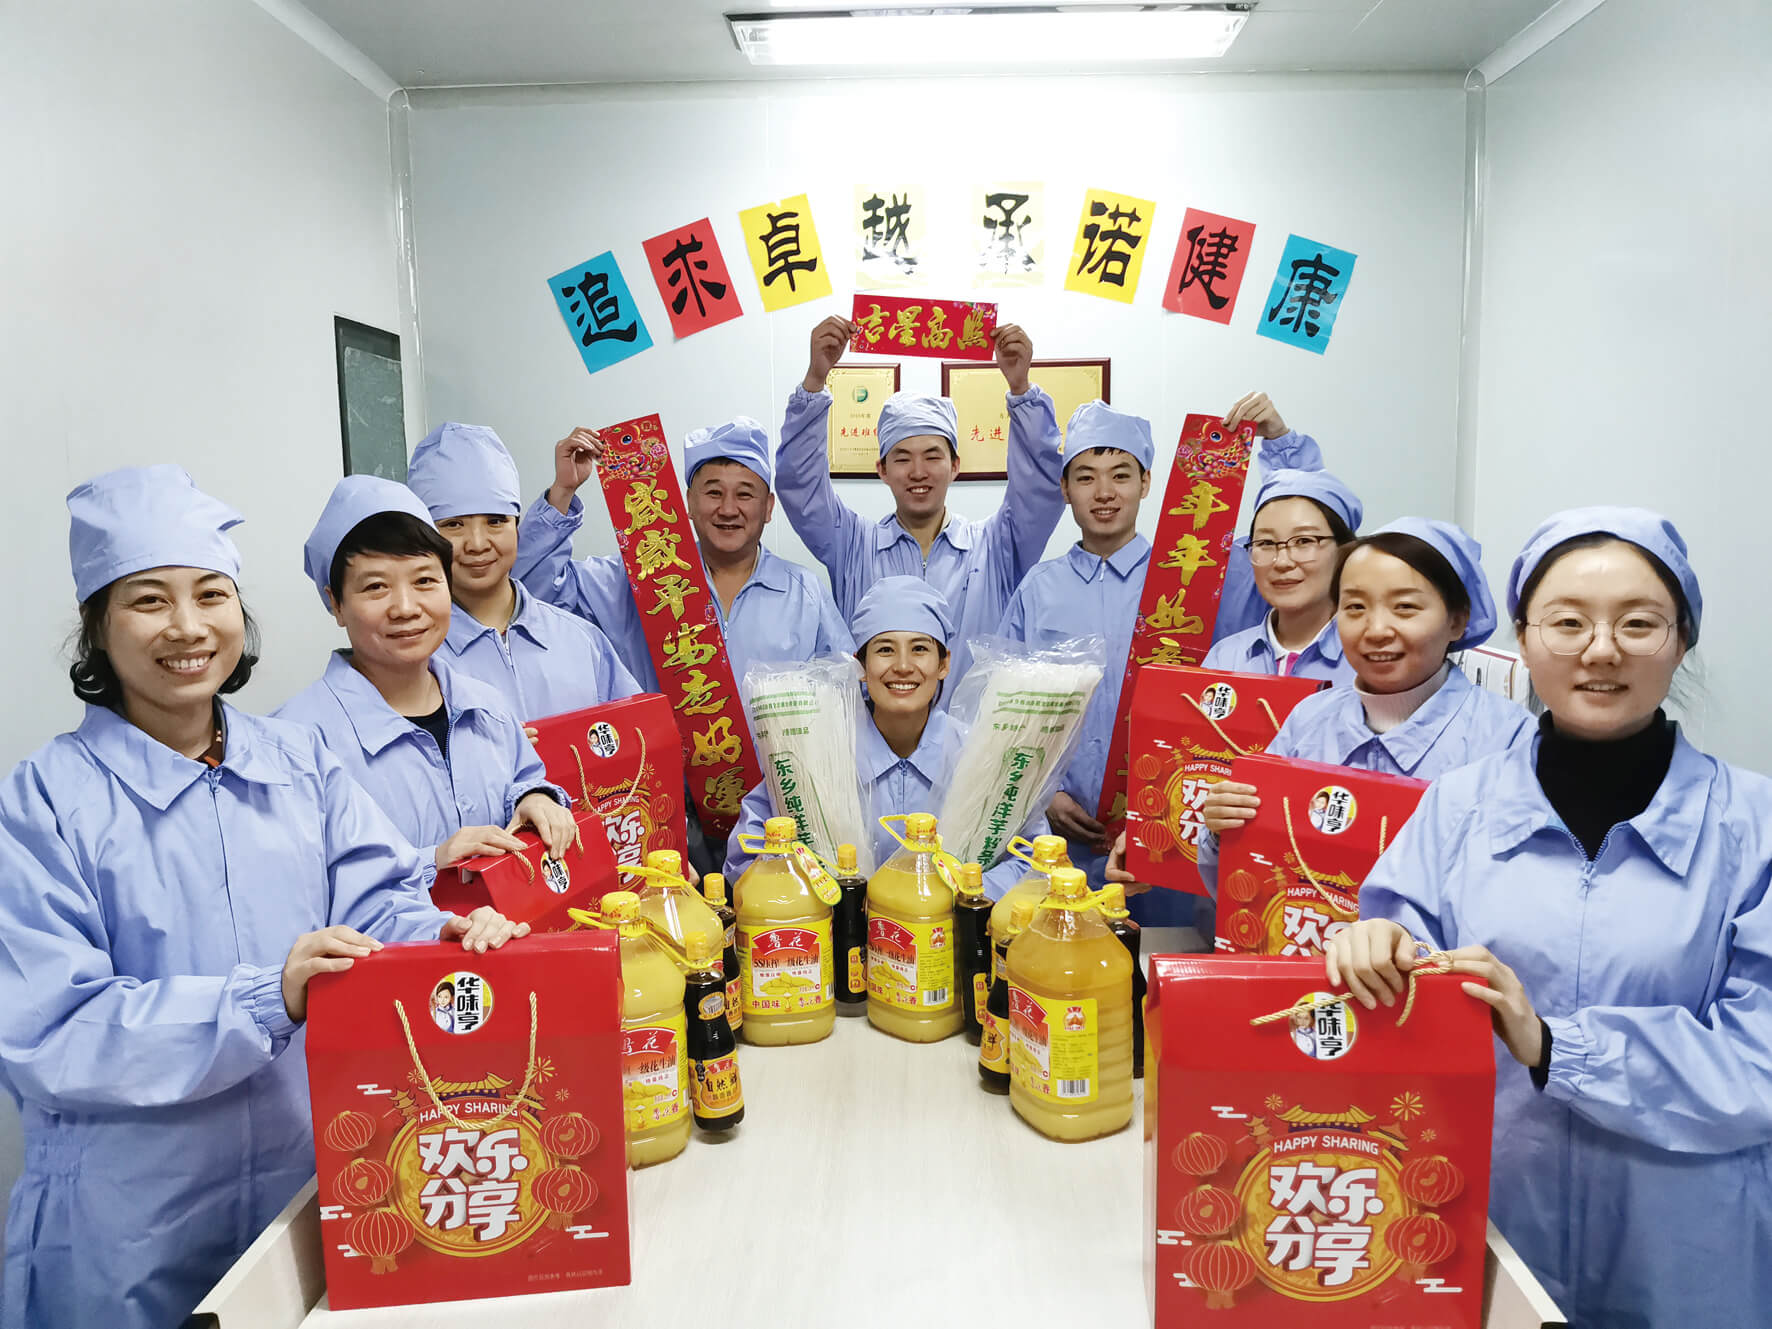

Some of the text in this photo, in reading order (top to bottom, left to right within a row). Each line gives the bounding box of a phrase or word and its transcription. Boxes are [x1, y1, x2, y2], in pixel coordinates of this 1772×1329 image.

[856, 303, 989, 351] 吉星高照
[1184, 763, 1232, 777] HAPPY SHARI
[1287, 887, 1317, 898] HAPPY
[418, 1128, 528, 1180] 欢乐
[1273, 1135, 1379, 1155] HAPPY SHARING
[420, 1178, 520, 1241] 分享
[1270, 1162, 1384, 1224] 欢乐
[1266, 1215, 1372, 1287] 分享
